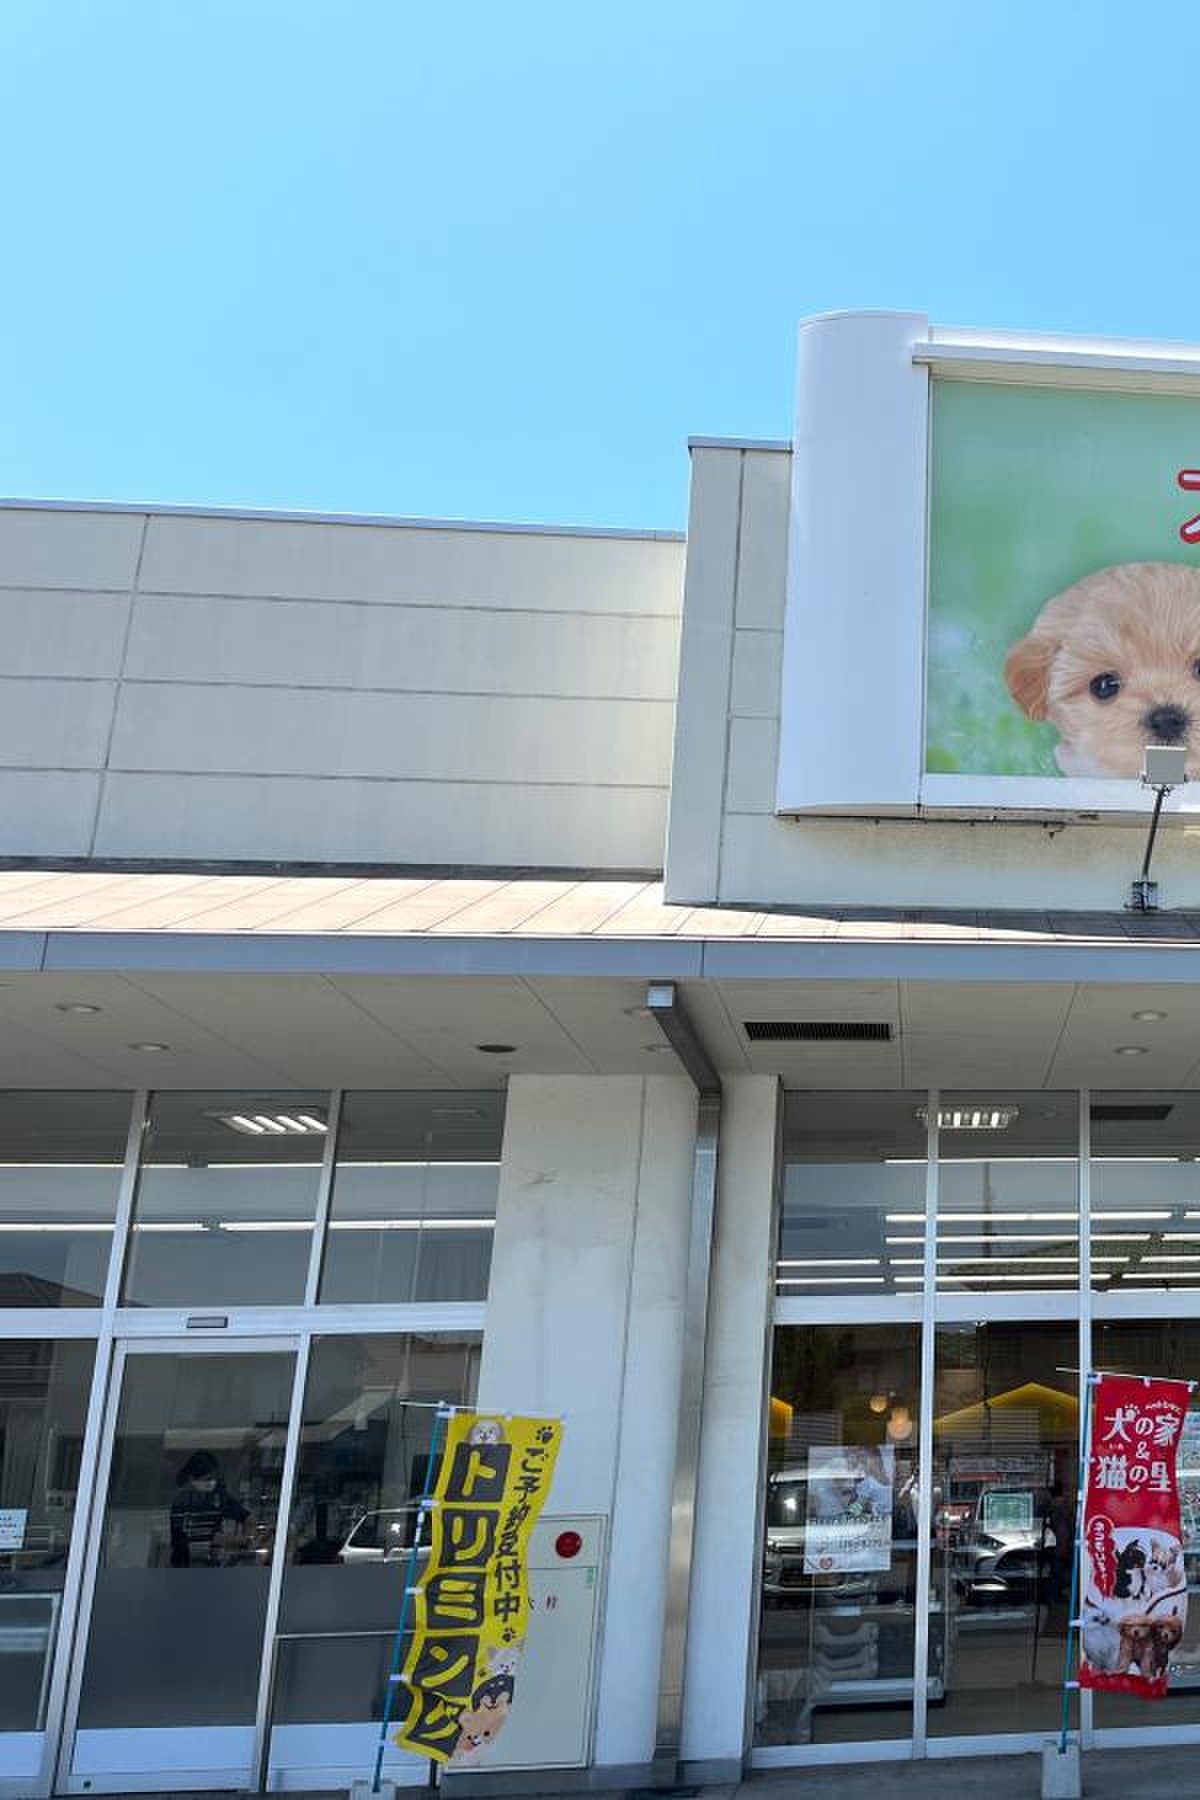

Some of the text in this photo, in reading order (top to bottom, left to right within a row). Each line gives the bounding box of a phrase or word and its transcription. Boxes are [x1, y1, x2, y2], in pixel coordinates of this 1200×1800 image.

[1102, 1404, 1181, 1446] 犬の家
[1095, 1455, 1172, 1493] 猫の里
